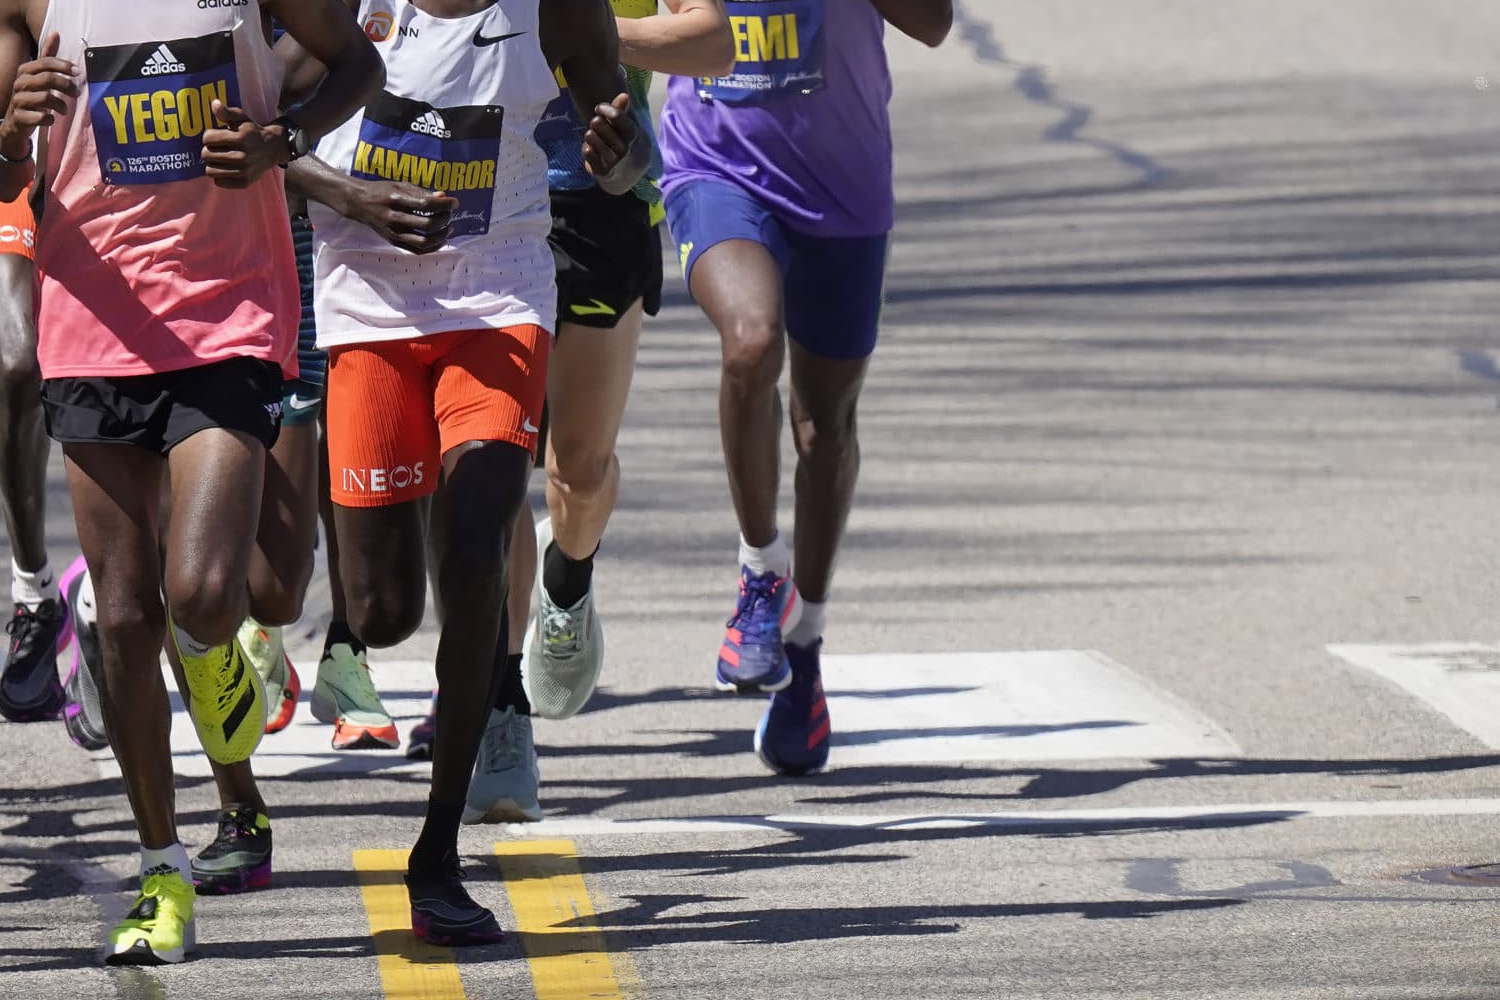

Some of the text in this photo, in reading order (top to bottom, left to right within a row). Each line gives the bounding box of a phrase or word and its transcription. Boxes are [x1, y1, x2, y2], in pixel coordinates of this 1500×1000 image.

[398, 26, 419, 38] NN
[728, 13, 800, 62] EMI
[141, 62, 186, 76] adidas
[103, 80, 228, 145] YEGON
[410, 120, 451, 139] adidas
[129, 160, 191, 173] MARATHON
[150, 152, 190, 164] BOSTON
[354, 140, 495, 191] KAMWOROR
[342, 461, 424, 492] INEOS
